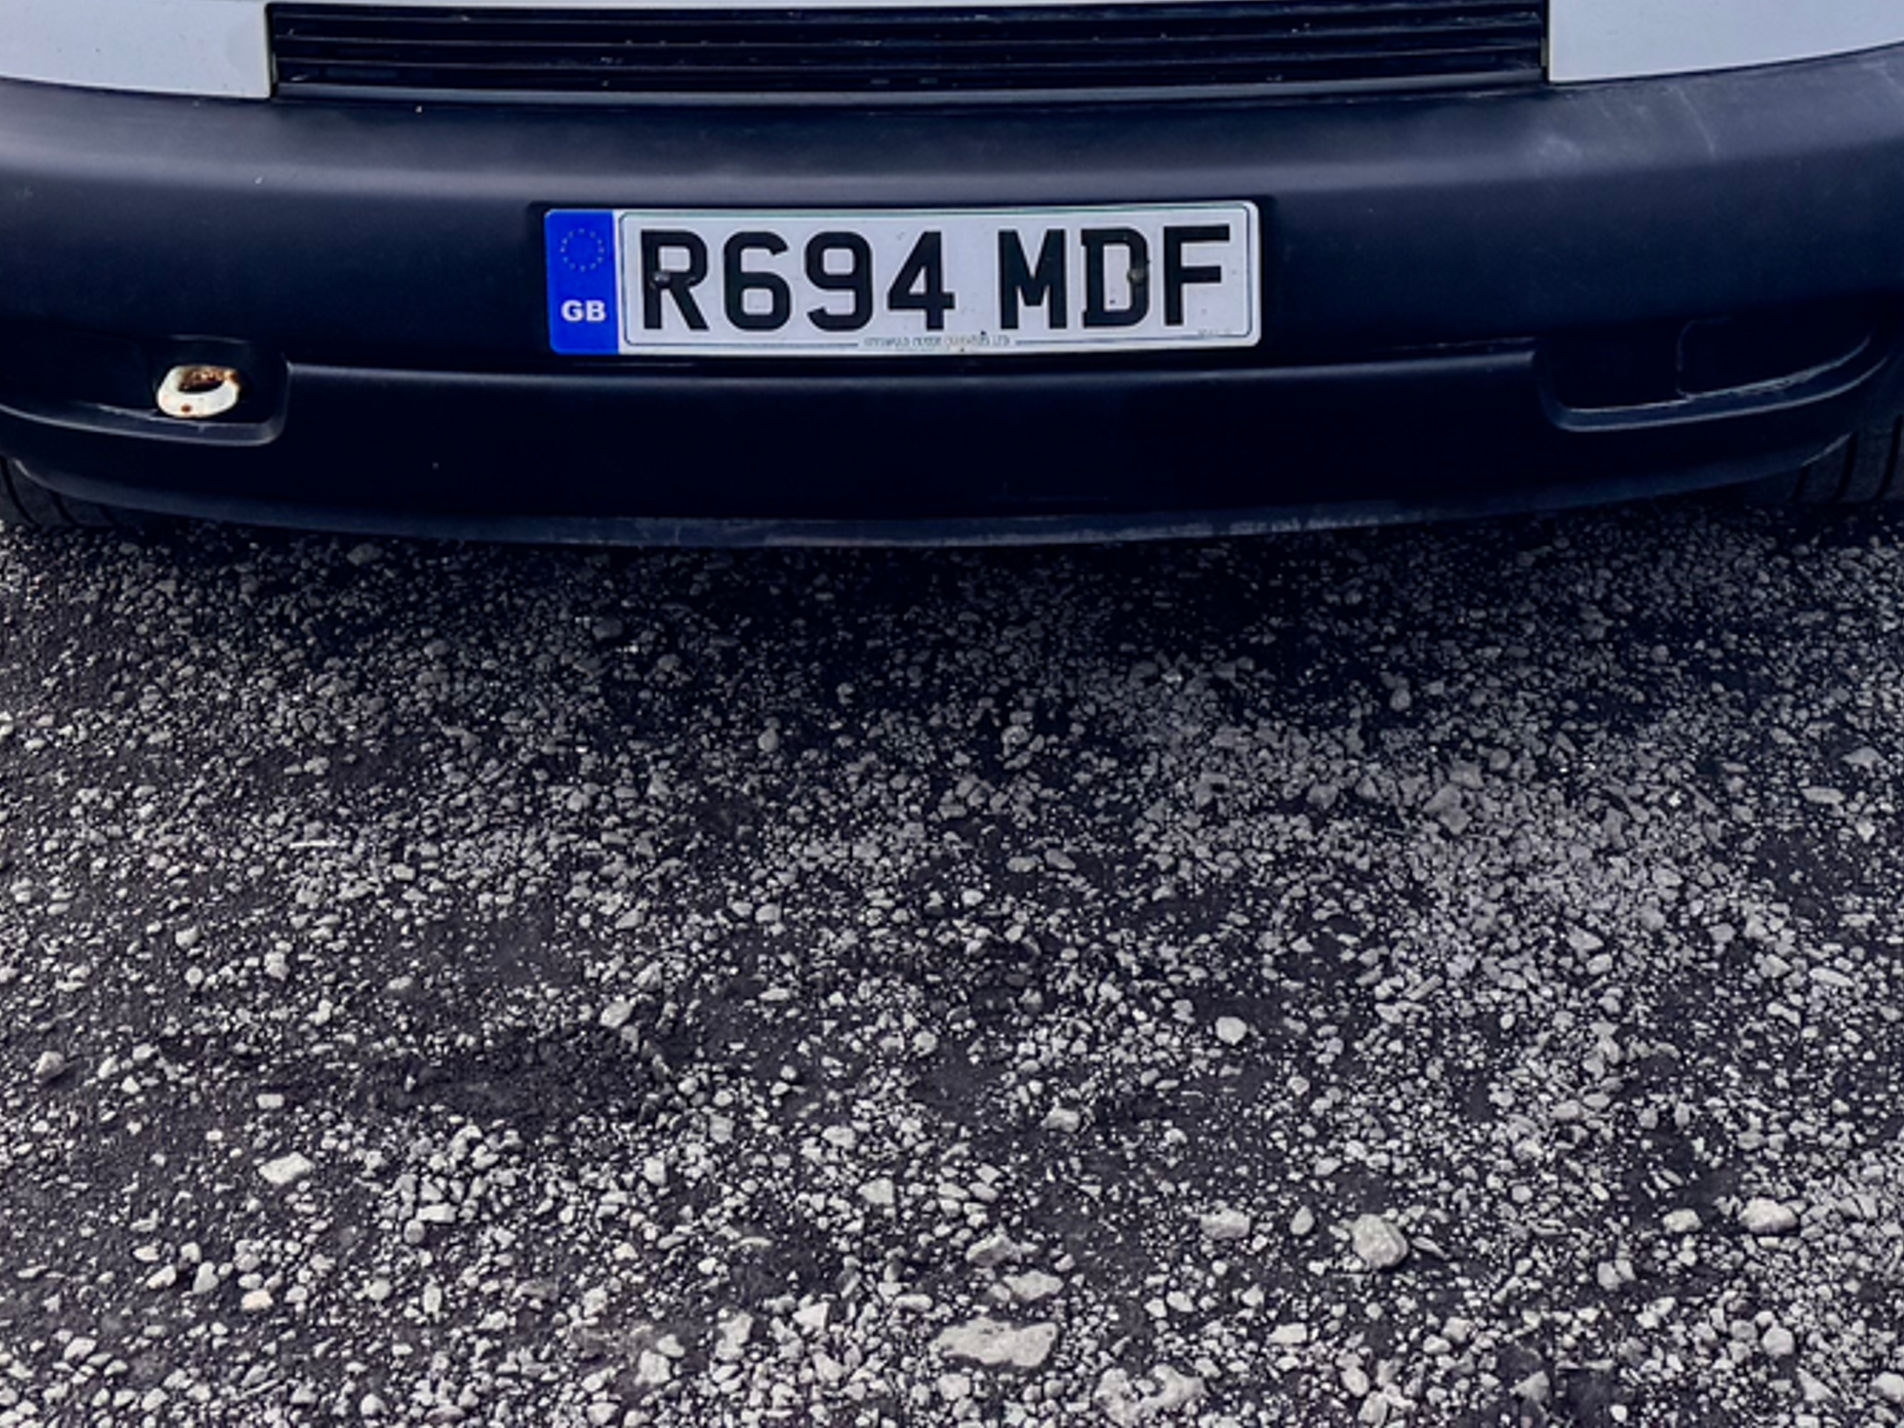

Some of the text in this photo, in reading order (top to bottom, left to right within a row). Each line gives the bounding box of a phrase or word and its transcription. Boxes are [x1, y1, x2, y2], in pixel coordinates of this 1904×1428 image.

[641, 224, 1231, 332] R694 MDF
[561, 300, 607, 323] GB
